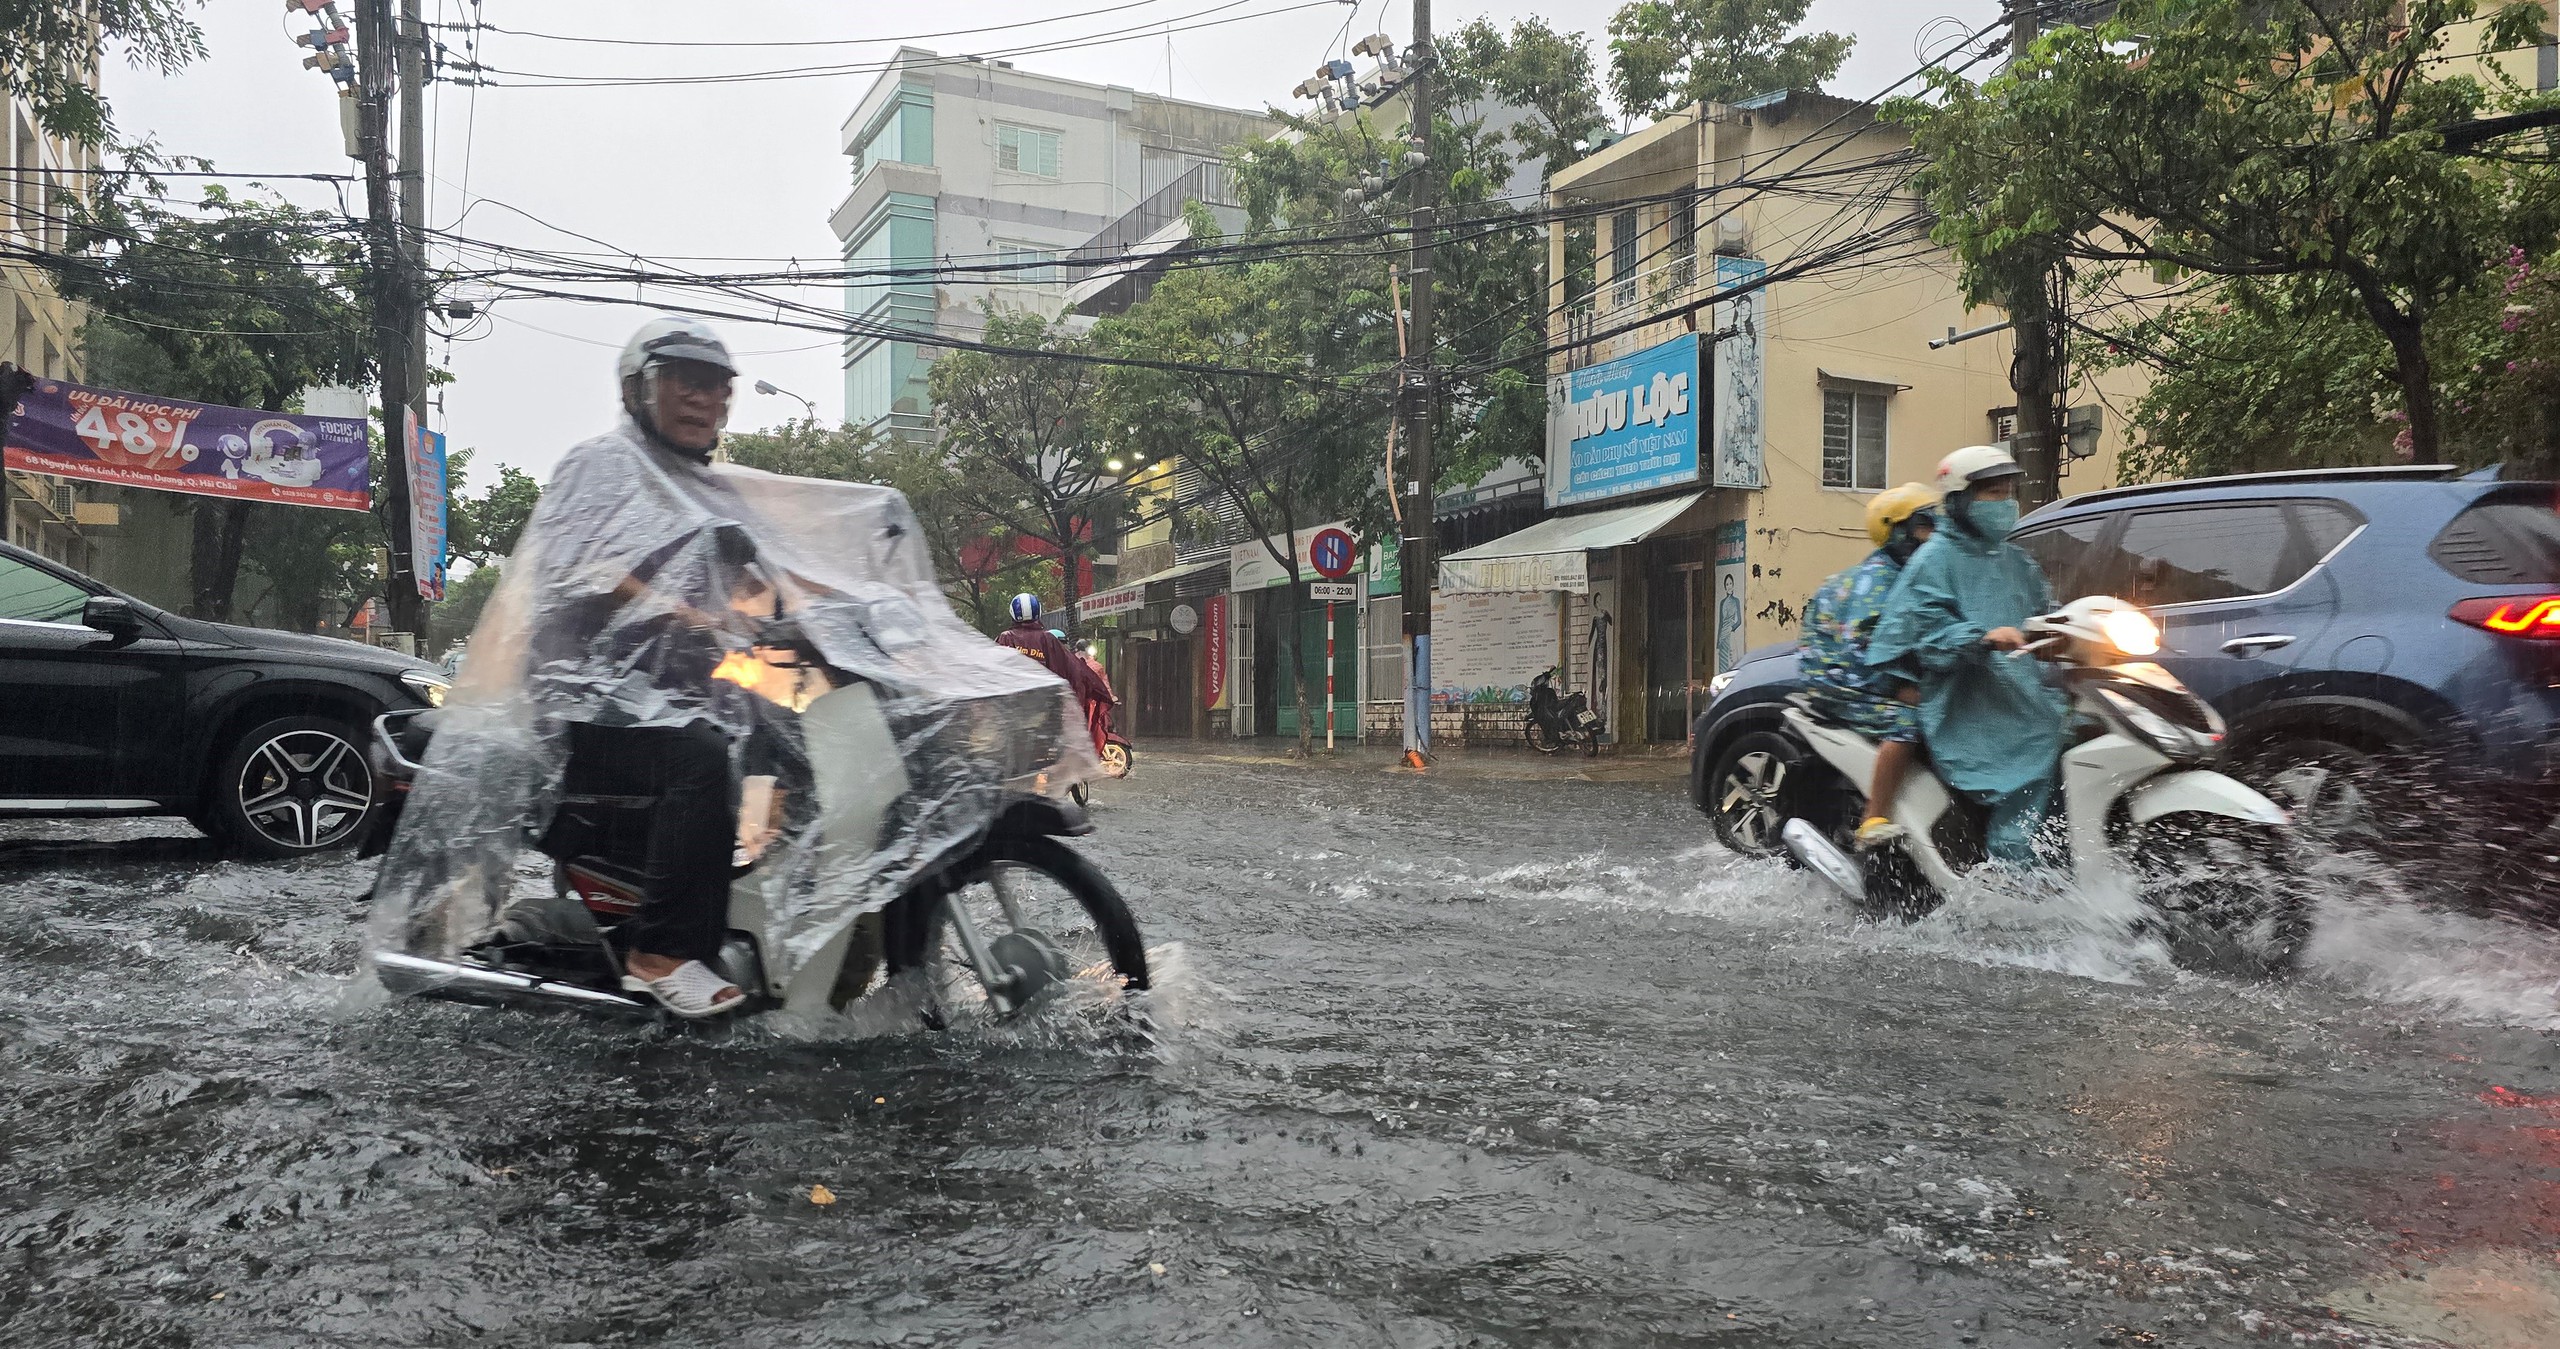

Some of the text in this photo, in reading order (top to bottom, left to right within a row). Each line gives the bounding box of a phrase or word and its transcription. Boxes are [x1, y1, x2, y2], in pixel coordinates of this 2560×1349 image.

[98, 395, 128, 410] ĐÃI
[131, 401, 170, 419] HỌC
[172, 407, 203, 420] PHÍ
[1571, 372, 1689, 440] HỮU LỘC
[75, 405, 200, 461] 48%
[319, 421, 354, 437] FOCUS
[1602, 444, 1622, 463] PHỤ
[1640, 432, 1661, 455] VIỆT
[1663, 429, 1688, 448] NAM
[25, 455, 39, 465] 68
[78, 462, 95, 472] Văn
[121, 469, 130, 478] P.
[131, 471, 152, 480] Nam
[187, 478, 198, 487] Q.
[1591, 466, 1614, 481] CÁCH
[1616, 462, 1638, 476] THEO
[1480, 559, 1515, 588] HỮU
[1518, 556, 1552, 591] LỘC
[1314, 585, 1330, 595] 06:00
[1336, 586, 1353, 596] 22:00
